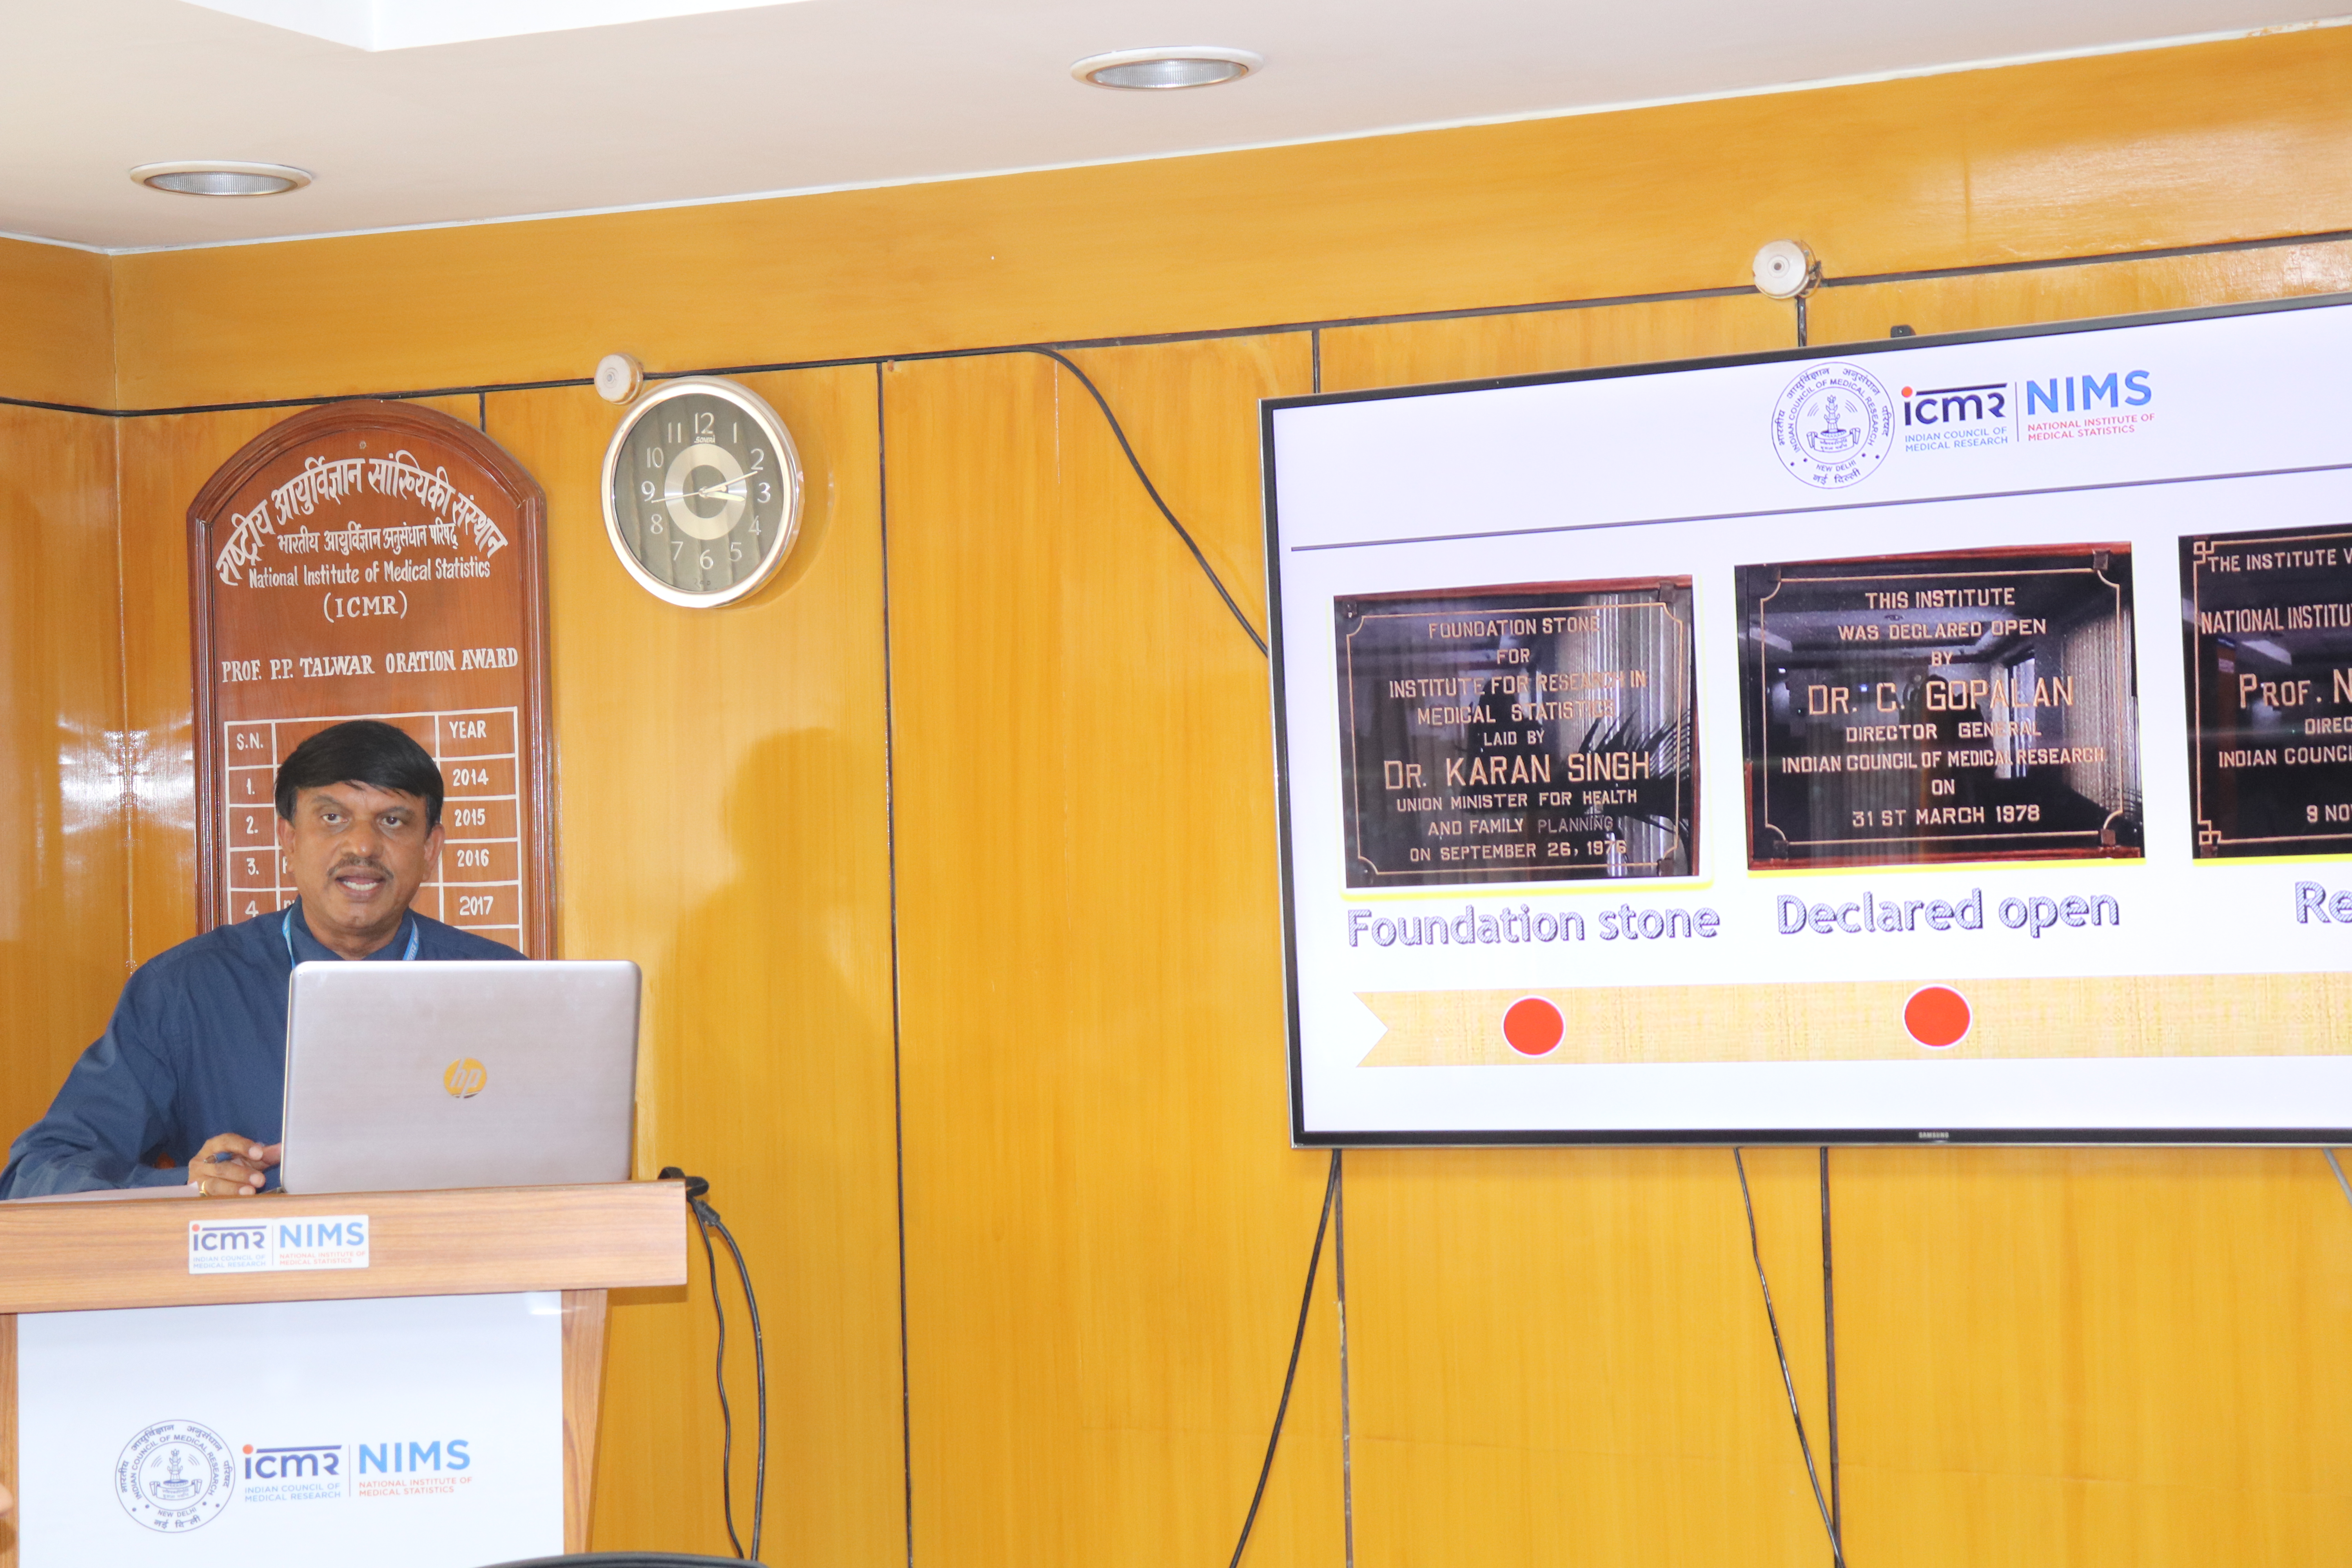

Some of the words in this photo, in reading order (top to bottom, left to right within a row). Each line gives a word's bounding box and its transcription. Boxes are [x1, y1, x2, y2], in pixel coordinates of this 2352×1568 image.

[1816, 380, 1827, 388] OF
[1830, 379, 1865, 397] MEDICAL
[2027, 370, 2152, 415] NIMS
[1789, 387, 1815, 420] COUNCIL
[695, 412, 714, 434] 12
[1865, 396, 1878, 446] RESEARCH
[2028, 421, 2081, 431] NATIONAL
[2085, 414, 2137, 426] INSTITUTE
[2141, 413, 2154, 421] OF
[668, 422, 681, 443] 11
[733, 422, 737, 443] 1
[1788, 423, 1800, 453] INDIAN
[1905, 432, 1940, 442] INDIAN
[1944, 428, 1989, 439] COUNCIL
[1993, 426, 2007, 435] OF
[2029, 430, 2074, 441] MEDICAL
[2078, 425, 2134, 437] STATISTICS
[1906, 441, 1950, 452] MEDICAL
[1954, 436, 2007, 448] RESEARCH
[647, 447, 664, 468] 10
[751, 448, 764, 470] 2
[1836, 460, 1856, 471] DELHI
[641, 481, 655, 502] 9
[757, 483, 771, 503] 3
[650, 514, 663, 534] 8
[748, 515, 762, 535] 4
[277, 525, 320, 554] भारतीय
[324, 521, 381, 555] आयुर्विज्ञान
[383, 521, 427, 555] अनुसंधान
[671, 541, 683, 561] 7
[700, 549, 714, 569] 6
[730, 542, 742, 562] 5
[2208, 556, 2240, 572] THE
[2247, 548, 2337, 571] INSTITUTE
[249, 566, 298, 589] National
[304, 564, 359, 586] Institute
[365, 565, 379, 583] of
[384, 559, 431, 582] Medical
[436, 557, 491, 579] Statistics
[323, 590, 408, 623] (ICMR)
[1865, 592, 1908, 609] THIS
[1916, 588, 2015, 607] INSTITUTE
[1429, 619, 1536, 638] FOUNDATION
[1543, 616, 1600, 633] STONE
[2201, 608, 2283, 634] NATIONAL
[2288, 603, 2352, 630] INSTITU
[1838, 624, 1879, 640] WAS
[1889, 622, 1982, 639] DECLARED
[1992, 619, 2047, 635] OPEN
[222, 660, 261, 682] PROF.
[270, 659, 293, 679] P.P.
[300, 655, 375, 677] TALWAR
[386, 650, 454, 673] ORATION
[461, 647, 518, 670] AWARD
[1497, 649, 1530, 664] FOR
[1931, 652, 1953, 666] BY
[1390, 678, 1485, 698] INSTITUTE
[1491, 675, 1528, 695] FOR
[1536, 671, 1624, 691] RESEARCH
[1631, 670, 1646, 688] IN
[1877, 682, 1905, 712] C.
[1926, 677, 2073, 710] GOPALAN
[1418, 705, 1495, 725] MEDICAL
[1511, 700, 1614, 722] STATISTICS
[449, 720, 487, 739] YEAR
[1483, 731, 1517, 746] LAID
[1527, 730, 1544, 744] BY
[1846, 724, 1937, 742] DIRECTOR
[1958, 721, 2042, 739] GENERAL
[236, 733, 263, 751] S.N.
[1782, 757, 1842, 773] INDIAN
[1847, 754, 1917, 770] COUNCIL
[1922, 752, 1940, 767] OF
[1948, 751, 2013, 767] MEDICAL
[2016, 748, 2104, 765] RESEARCH
[2219, 749, 2276, 767] INDIAN
[452, 769, 489, 786] 2014
[1446, 754, 1551, 787] KARAN
[1568, 751, 1650, 782] SINGH
[247, 779, 255, 795] 1.
[1932, 779, 1955, 795] ON
[1397, 797, 1442, 813] UNION
[1451, 793, 1527, 809] MINISTER
[1539, 792, 1572, 806] FOR
[1583, 789, 1637, 804] HEALTH
[455, 809, 485, 826] 2015
[1916, 806, 1984, 824] MARCH
[1996, 806, 2040, 822] 1978
[2307, 805, 2318, 823] 9
[2325, 803, 2352, 821] NO
[246, 817, 258, 834] 2.
[1428, 821, 1461, 835] AND
[1470, 818, 1524, 834] FAMILY
[1538, 817, 1613, 833] PLANNING
[457, 849, 489, 867] 2016
[1410, 848, 1430, 862] ON
[1441, 844, 1536, 860] SEPTEMBER
[1548, 842, 1579, 856] 26,
[1588, 841, 1627, 855] 1976
[246, 857, 259, 875] 3.
[459, 896, 494, 916] 2017
[1777, 888, 1984, 934] Declared
[1999, 894, 2120, 938] open
[1347, 904, 1584, 947] Foundation
[1598, 903, 1720, 940] stone
[449, 1058, 482, 1098] hp
[280, 1222, 364, 1248] NIMS
[174, 1435, 208, 1452] MEDICAL
[132, 1442, 158, 1470] COUNCIL
[359, 1439, 470, 1474] NIMS
[207, 1452, 219, 1495] RESEARCH
[410, 1477, 456, 1486] INSTITUTE
[131, 1473, 142, 1500] INDIAN
[291, 1492, 340, 1500] RESEARCH
[404, 1486, 454, 1494] STATISTICS
[177, 1507, 197, 1517] DELHI
